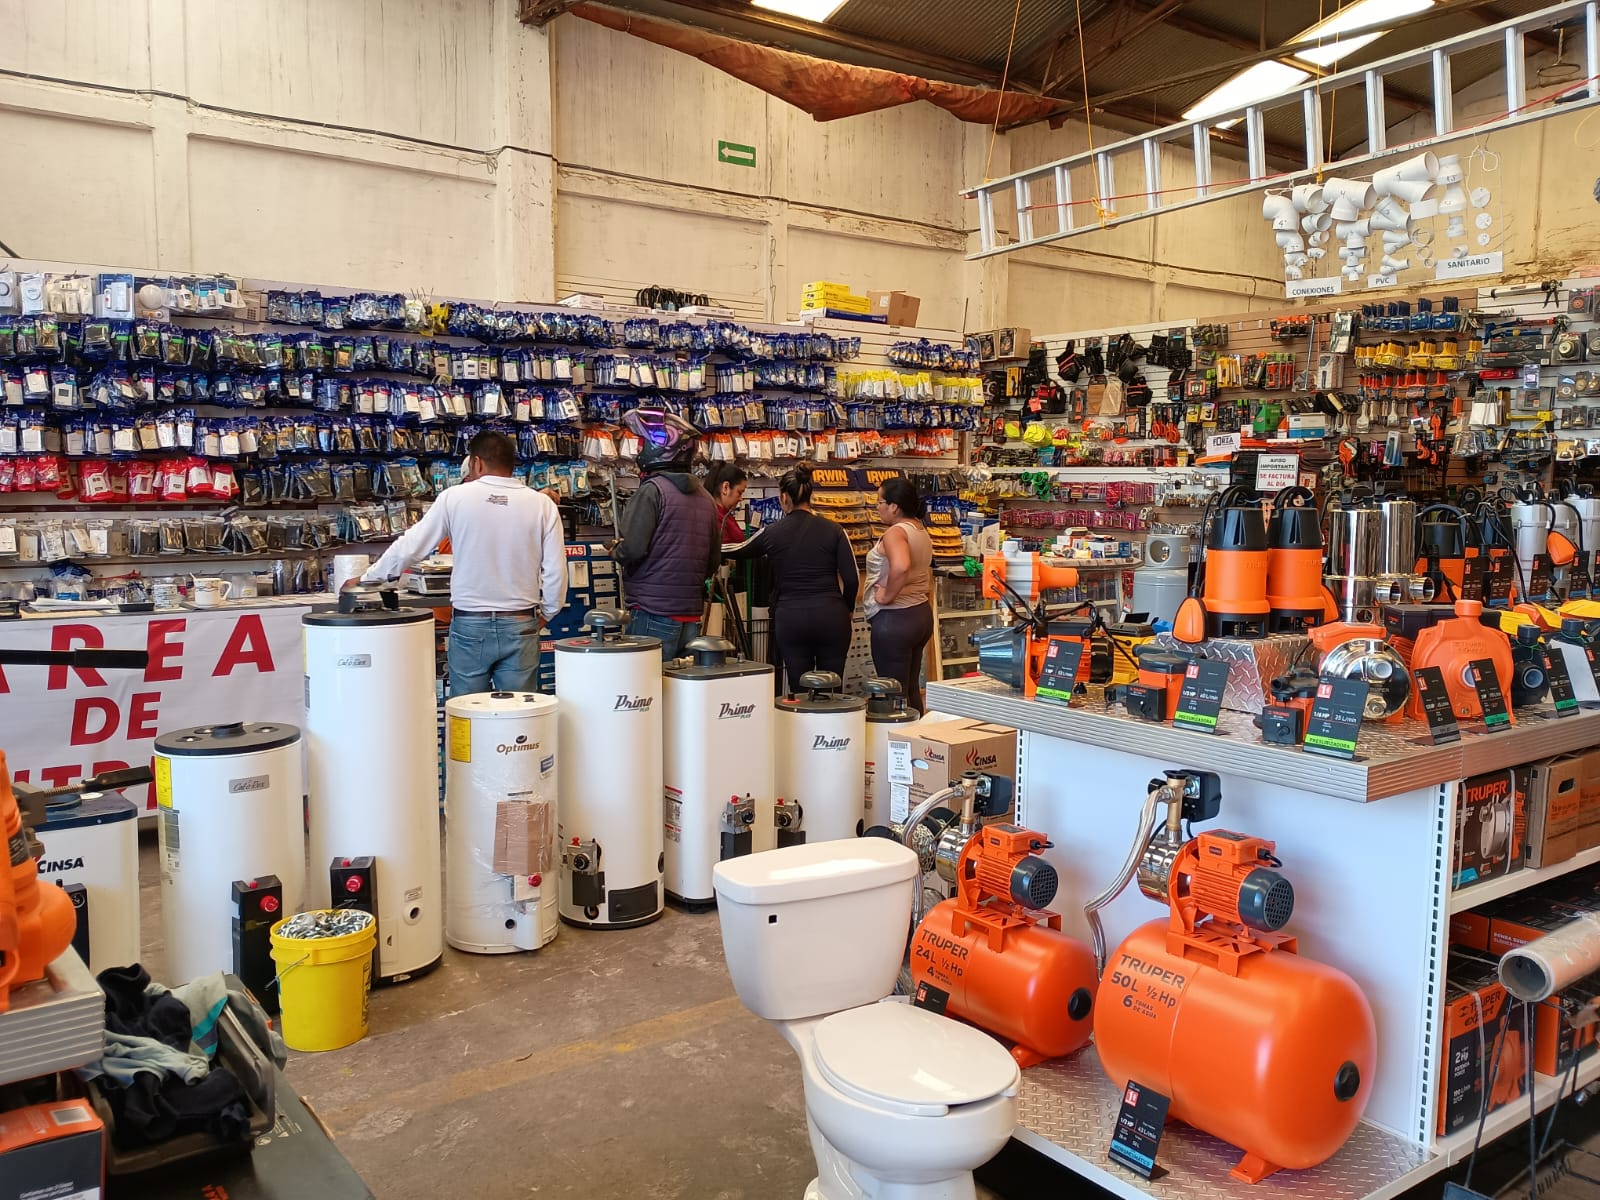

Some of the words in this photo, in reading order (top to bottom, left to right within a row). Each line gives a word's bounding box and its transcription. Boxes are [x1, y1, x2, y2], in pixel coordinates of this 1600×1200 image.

[1447, 257, 1490, 269] SANITARIO
[1375, 277, 1390, 285] PVC
[1292, 286, 1335, 297] CONEXIONES
[812, 469, 848, 482] IRWIN
[0, 613, 275, 693] REA
[613, 695, 653, 710] Primo
[718, 703, 756, 718] Primo
[70, 692, 162, 746] DE
[496, 742, 540, 755] Optimus
[813, 735, 851, 748] Primo
[974, 754, 997, 767] CINSA
[1466, 780, 1508, 803] TRUPER
[37, 857, 85, 874] CINSA
[921, 929, 969, 960] TRUPER
[927, 966, 935, 977] 4
[1120, 954, 1185, 989] TRUPER
[1123, 994, 1133, 1008] 6
